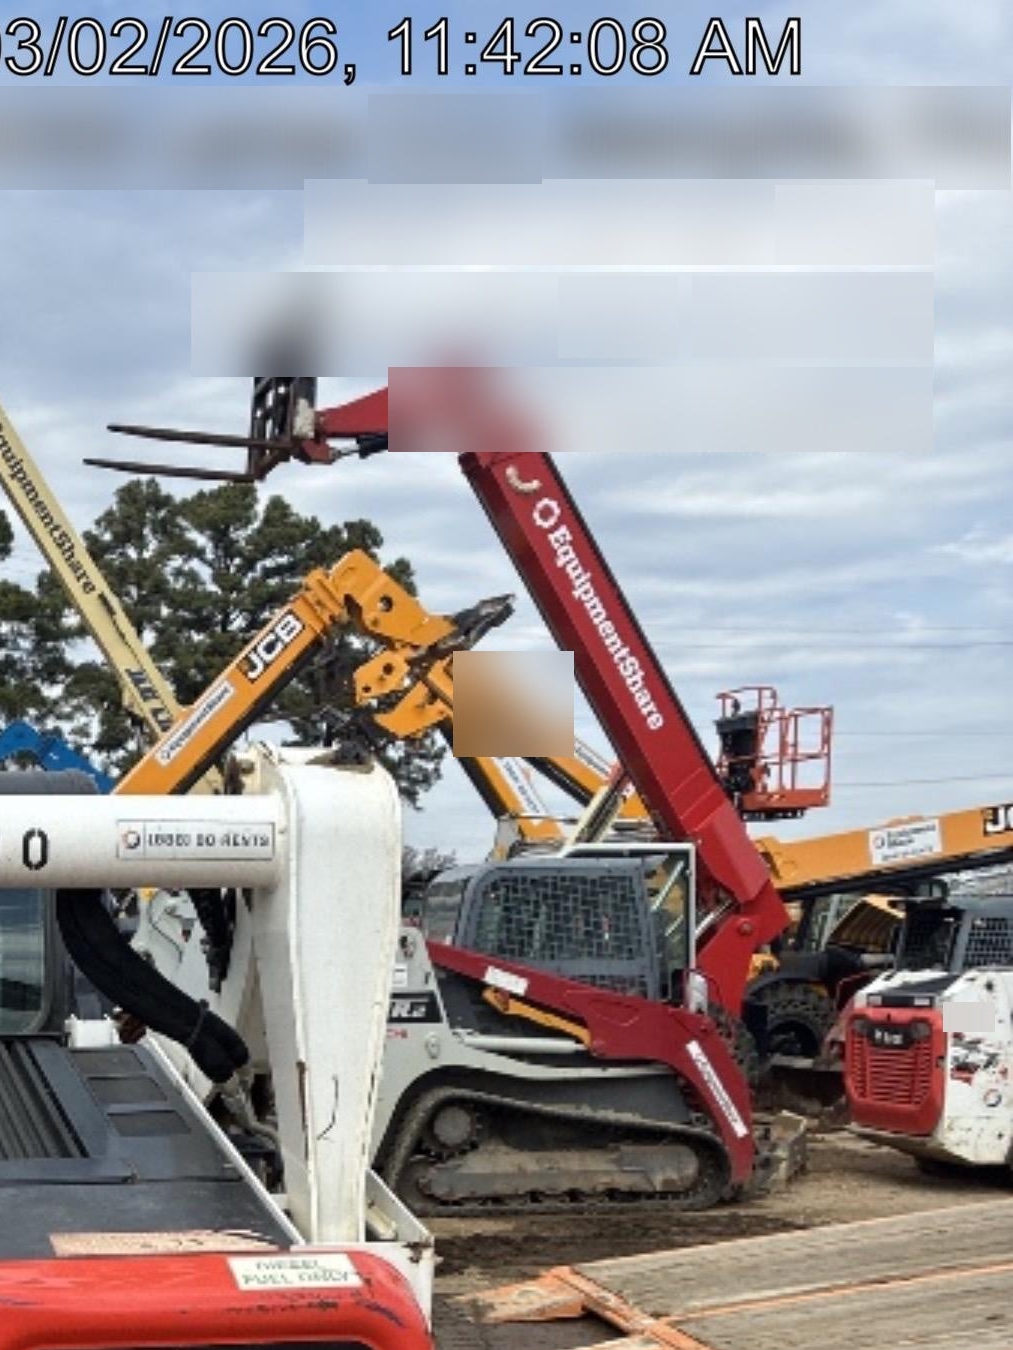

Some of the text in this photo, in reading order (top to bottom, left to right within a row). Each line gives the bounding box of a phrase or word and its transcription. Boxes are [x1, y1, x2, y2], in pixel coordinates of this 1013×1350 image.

[246, 613, 304, 679] JCB
[547, 523, 664, 731] EquipmentShare
[985, 804, 1013, 833] J
